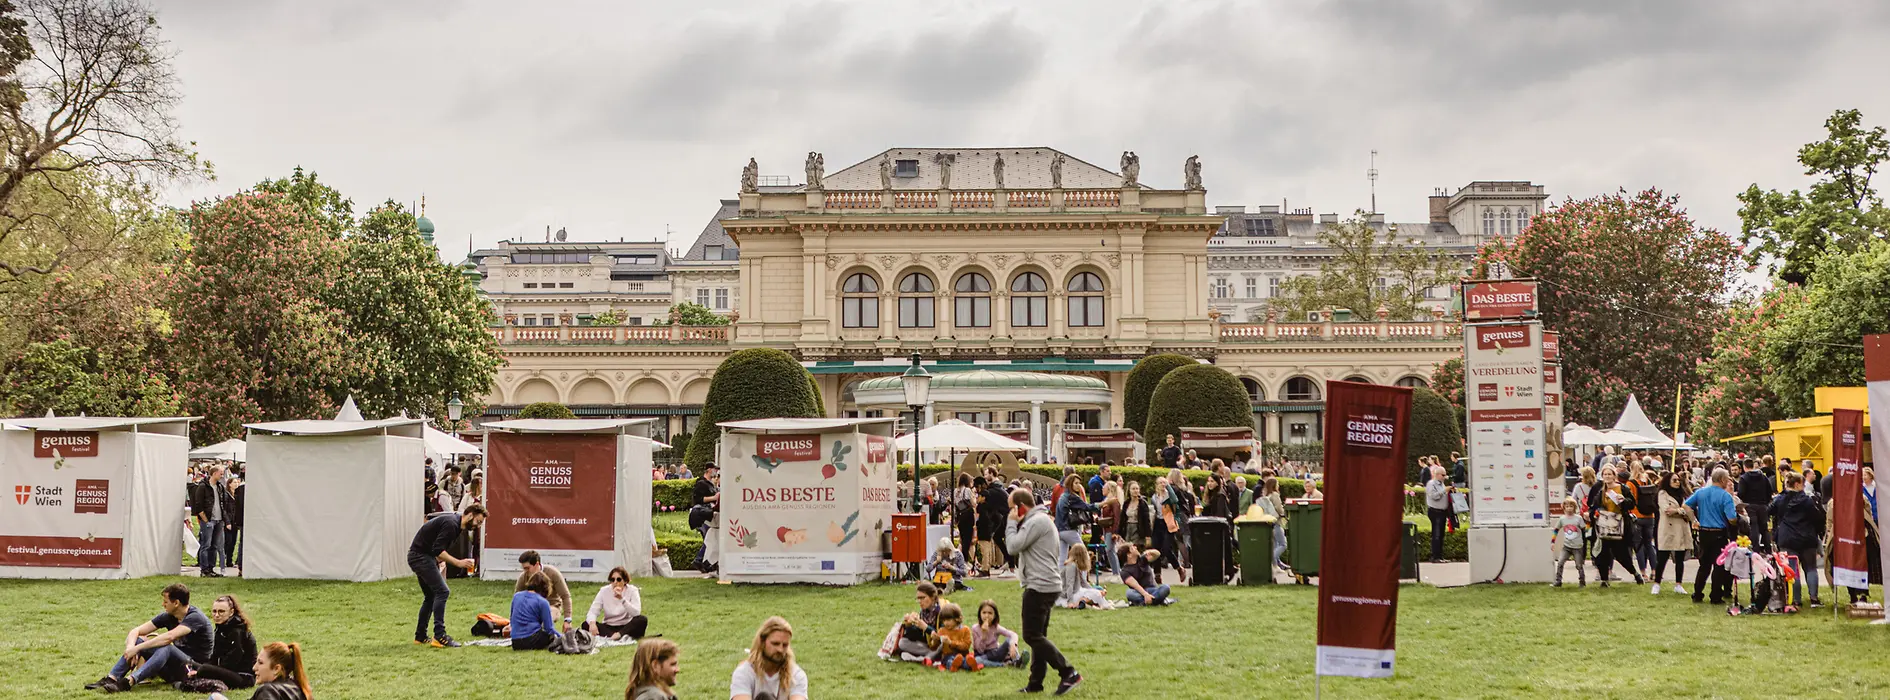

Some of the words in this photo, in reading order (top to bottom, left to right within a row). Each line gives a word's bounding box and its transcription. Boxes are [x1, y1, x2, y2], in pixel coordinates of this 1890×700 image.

[1472, 294, 1495, 304] DAS
[1496, 292, 1532, 303] BESTE
[1482, 330, 1524, 343] genuss
[1472, 366, 1537, 376] VEREDELUNG
[1347, 420, 1394, 434] GENUSS
[41, 434, 91, 449] genuss
[1347, 431, 1393, 444] REGION
[763, 438, 813, 454] genuss
[530, 466, 572, 476] GENUSS
[530, 476, 571, 485] REGION
[35, 485, 63, 496] Stadt
[76, 490, 107, 498] GENUSS
[742, 487, 777, 502] DAS
[780, 487, 835, 502] BESTE
[862, 487, 875, 502] DAS
[875, 487, 891, 502] BESTE
[35, 496, 62, 506] Wien
[76, 497, 106, 505] REGION
[512, 516, 588, 526] genussregionen.at
[7, 545, 112, 557] festival.genussregionen.at
[1332, 594, 1391, 606] genussregionen.at
